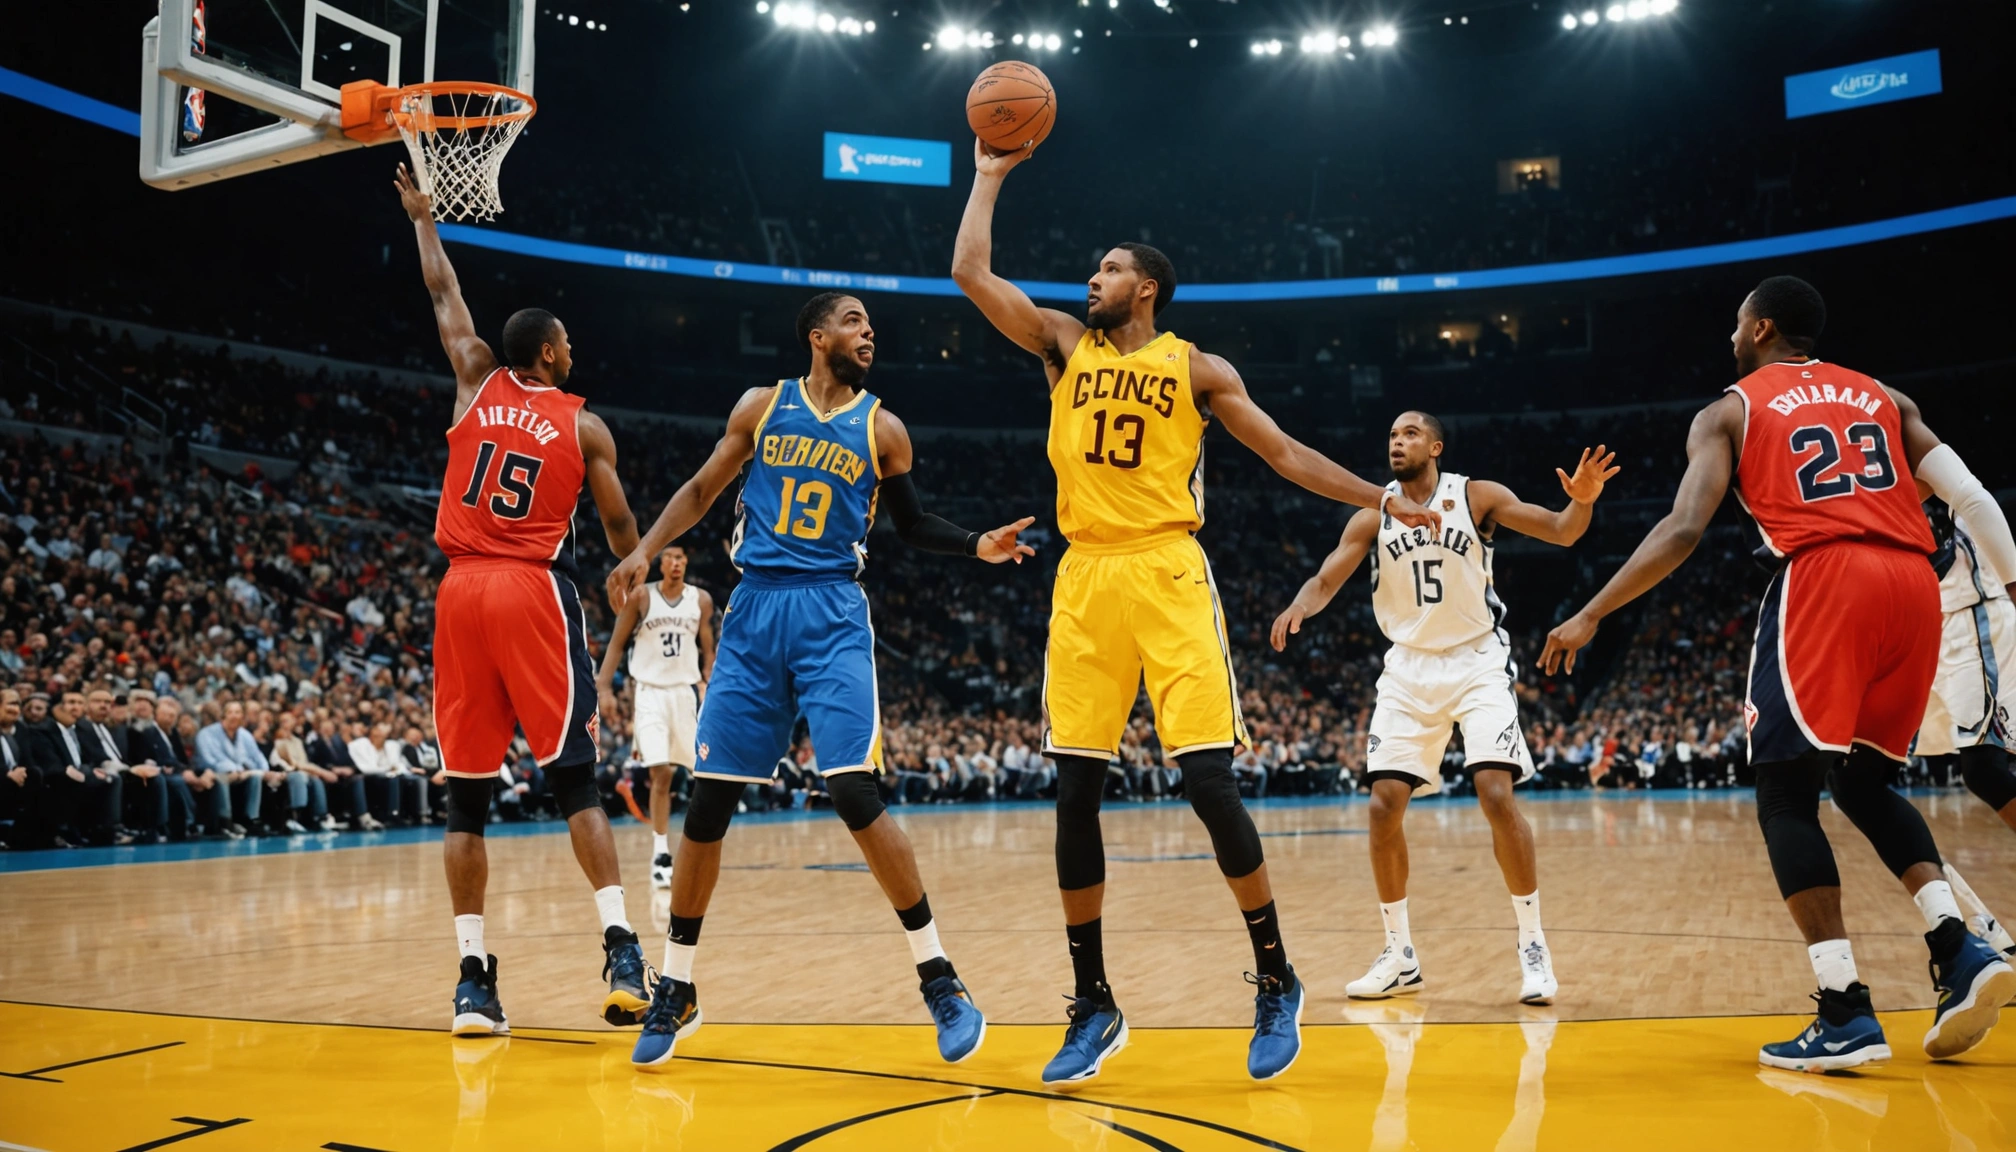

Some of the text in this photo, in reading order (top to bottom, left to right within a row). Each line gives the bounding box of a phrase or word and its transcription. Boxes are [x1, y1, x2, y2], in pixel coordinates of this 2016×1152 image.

[1085, 409, 1145, 469] 13
[1789, 421, 1898, 503] 23
[461, 440, 544, 521] 15
[773, 476, 833, 540] 13
[1412, 558, 1444, 607] 15
